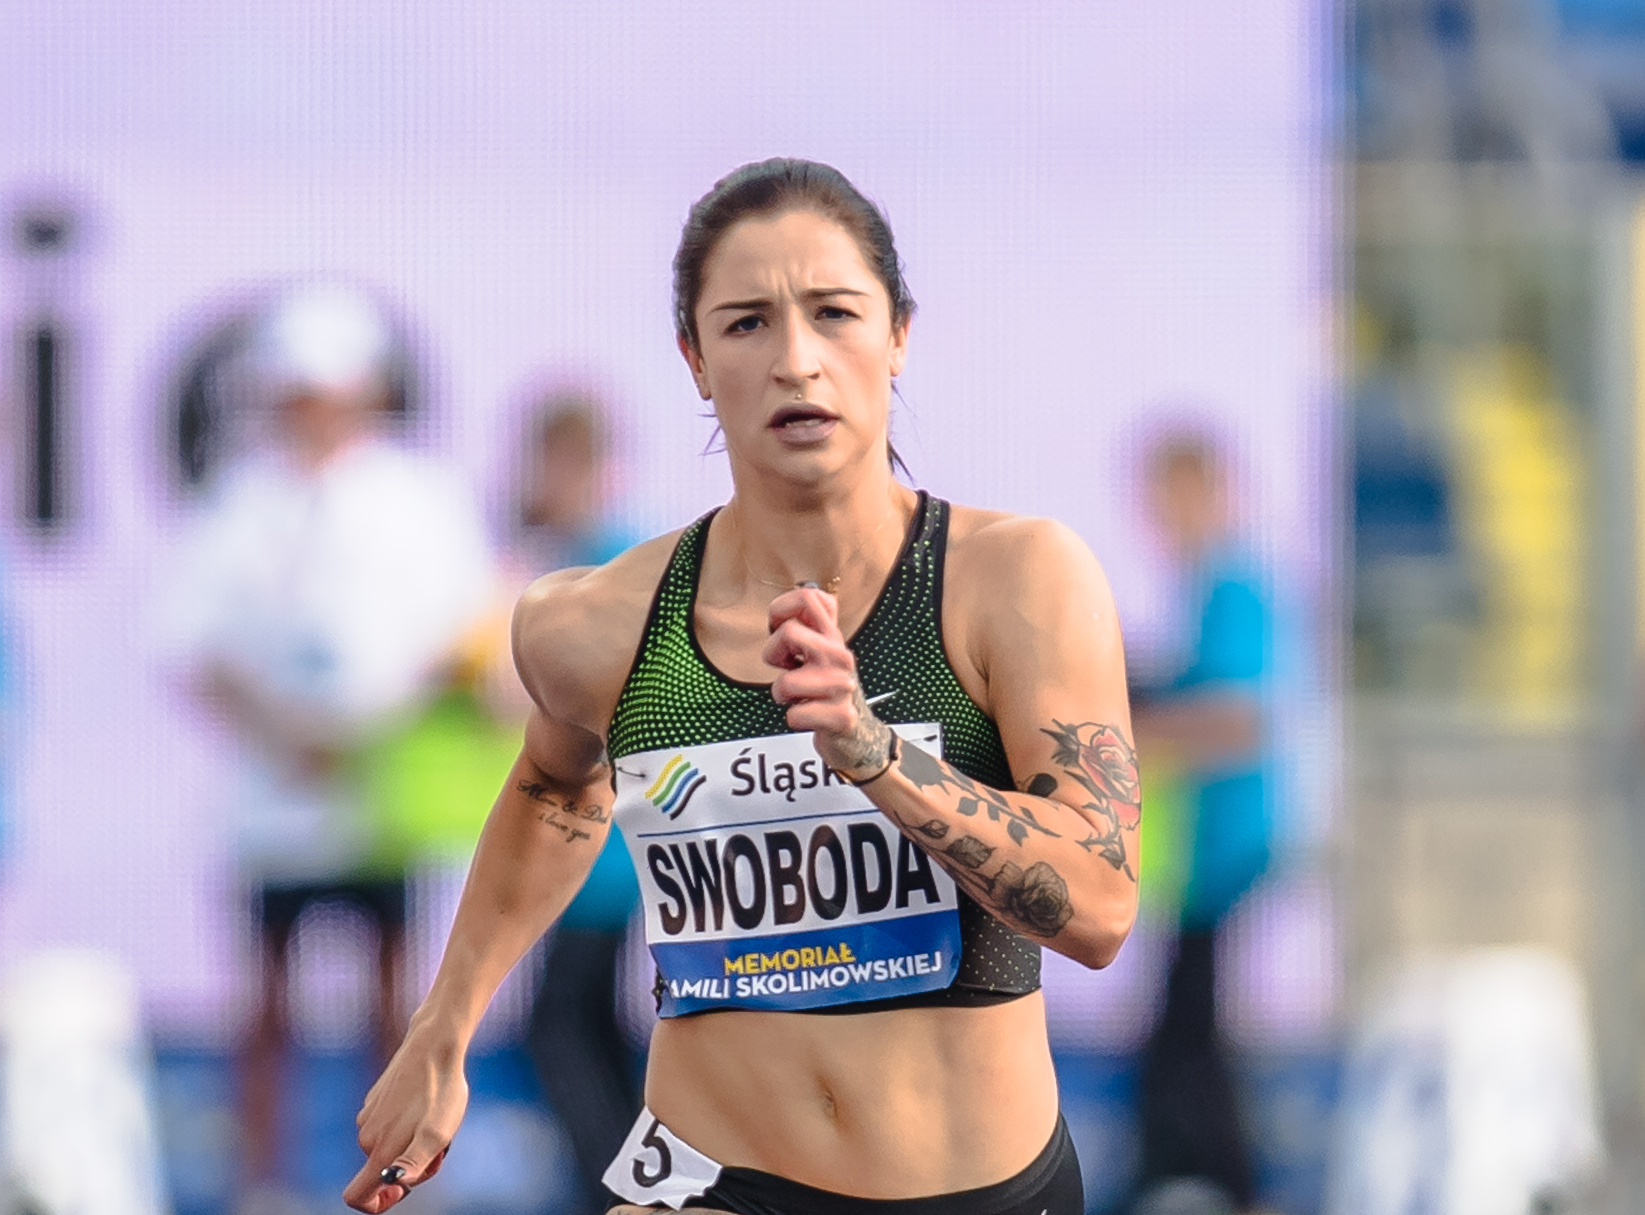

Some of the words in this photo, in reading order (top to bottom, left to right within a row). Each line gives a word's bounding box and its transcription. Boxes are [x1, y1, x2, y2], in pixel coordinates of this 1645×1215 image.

[646, 822, 941, 936] SWOBODA
[665, 978, 730, 999] AMILI
[736, 951, 943, 998] SKOLIMOWSKIEJ
[723, 942, 857, 976] MEMORIAŁ
[632, 1118, 672, 1188] 5
